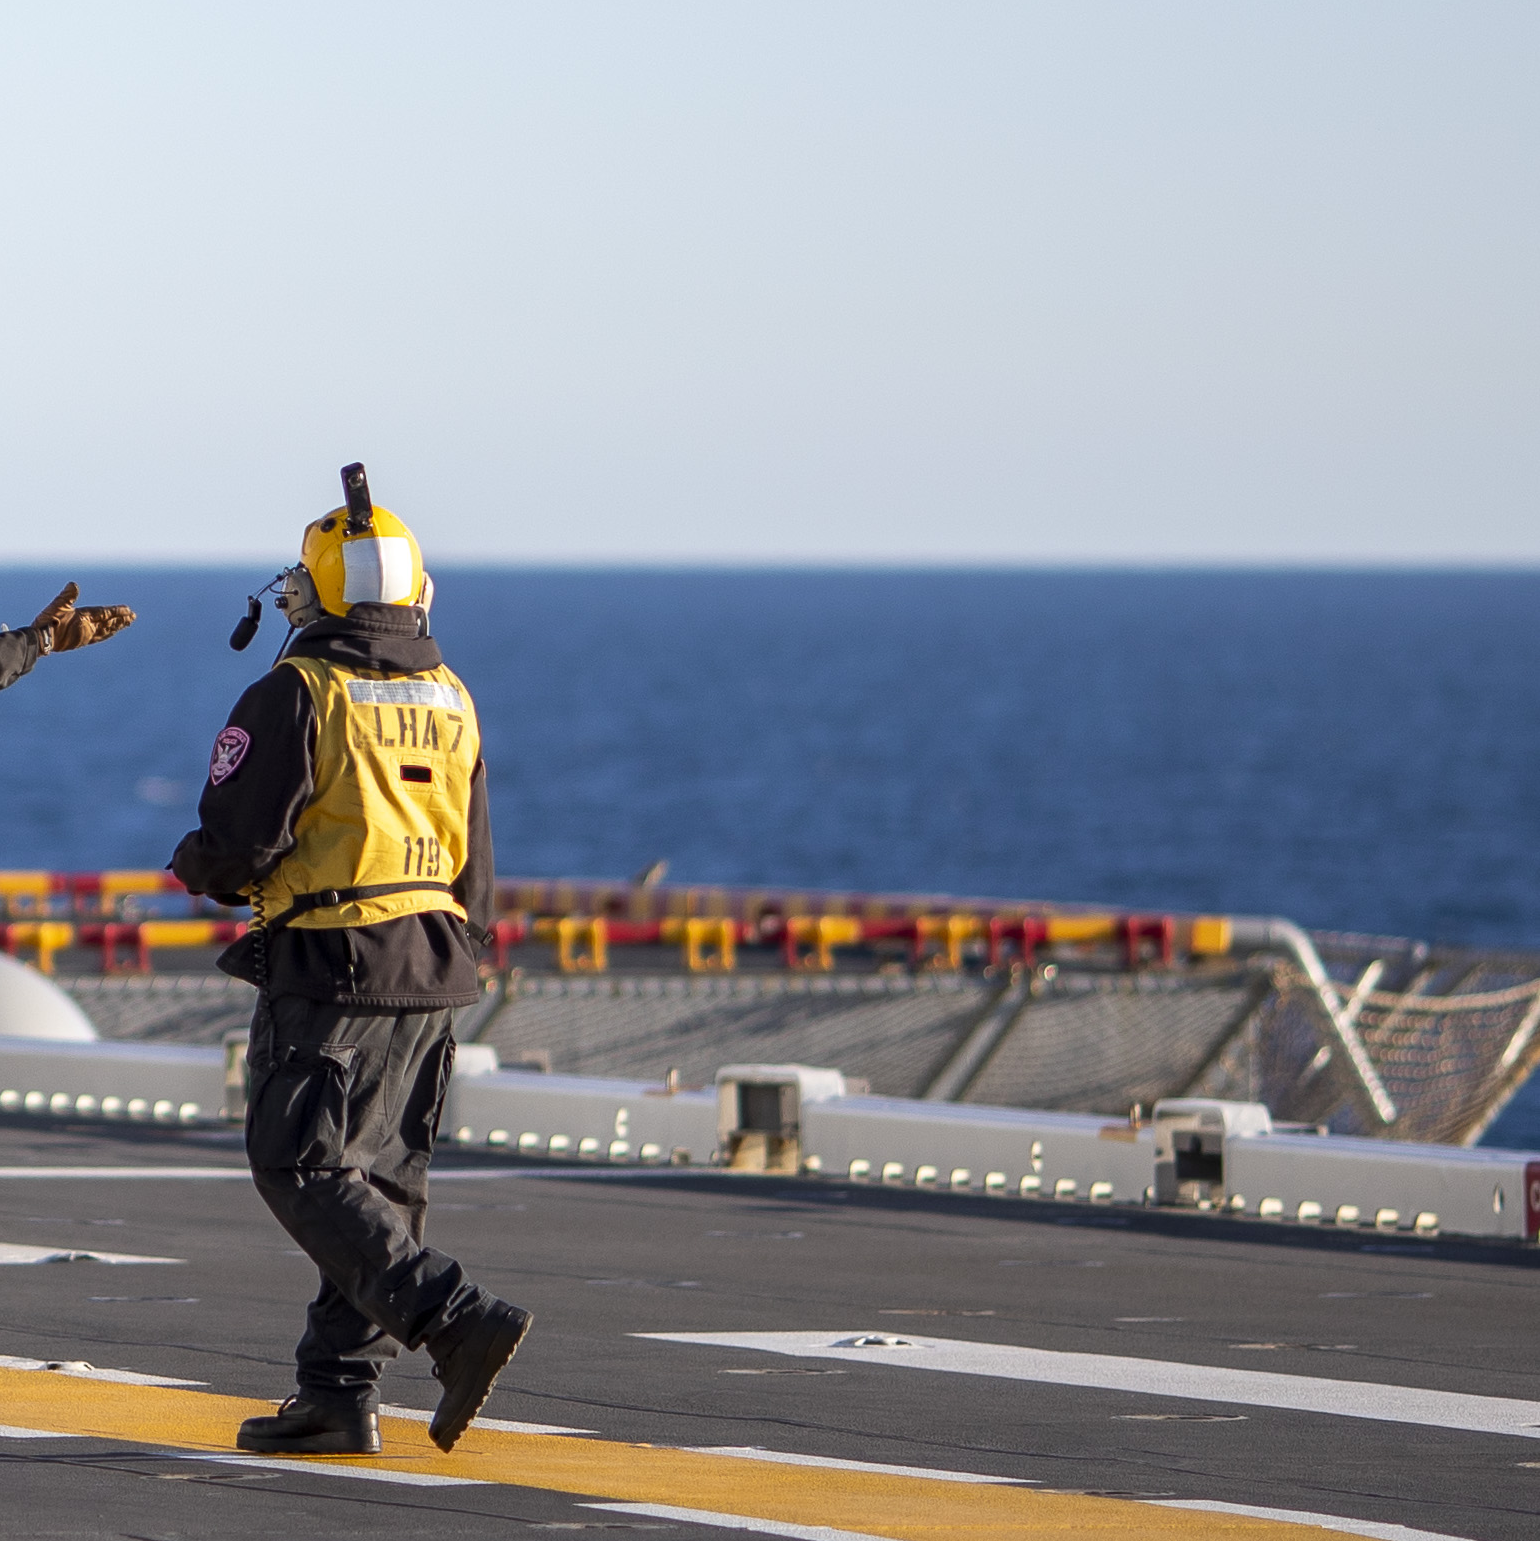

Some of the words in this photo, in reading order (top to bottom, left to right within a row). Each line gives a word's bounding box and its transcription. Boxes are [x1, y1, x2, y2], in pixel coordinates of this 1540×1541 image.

[374, 706, 439, 751] LHA
[446, 713, 464, 753] 7
[404, 836, 440, 877] 119
